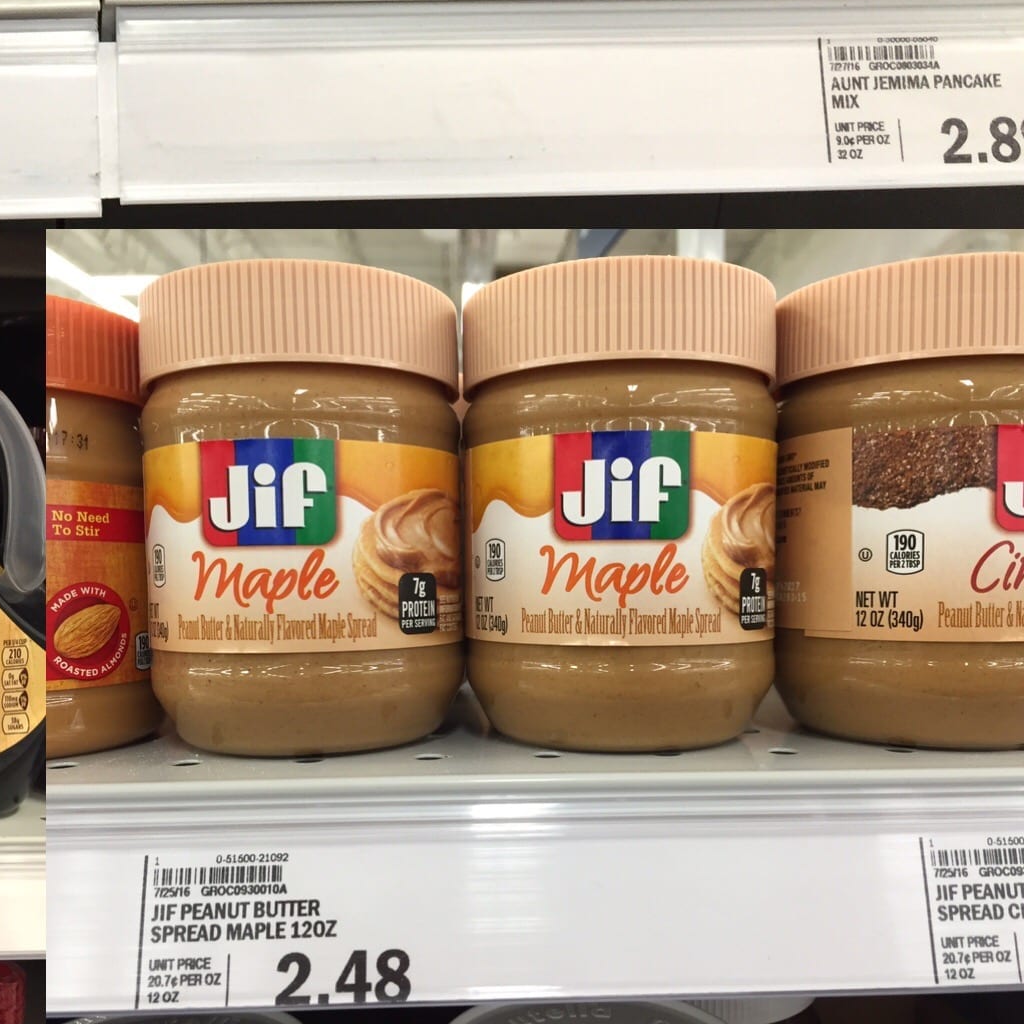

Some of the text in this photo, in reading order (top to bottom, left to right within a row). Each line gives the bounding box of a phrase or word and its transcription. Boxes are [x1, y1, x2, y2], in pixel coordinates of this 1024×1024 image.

[831, 73, 1002, 91] AUNT JEMIMA PANCAKE
[832, 94, 860, 109] MIX
[940, 116, 1024, 164] 2.8
[209, 462, 328, 531] Jif
[562, 456, 682, 525] Jif
[51, 510, 110, 523] No Need
[53, 525, 100, 537] To Stir
[894, 535, 916, 550] 190
[192, 548, 340, 614] Maple
[539, 543, 689, 608] Maple
[413, 578, 426, 597] 7g
[50, 587, 107, 613] MADE WITH
[402, 600, 435, 617] PROTEIN
[856, 591, 898, 608] NET WT
[178, 614, 199, 640] Peanut
[201, 614, 224, 640] Butter
[226, 615, 232, 640] &
[234, 614, 275, 644] Naturally
[276, 613, 316, 640] Flavored
[318, 613, 346, 643] Maple
[347, 612, 377, 643] Spread
[401, 618, 436, 628] PER SERVING
[856, 610, 924, 632] 12 OZ (340g)
[53, 656, 99, 677] ROASTED
[100, 632, 127, 673] ALMONDS
[154, 884, 287, 898] 7/25/16 GROC0930010A
[936, 884, 958, 901] JIF
[151, 899, 320, 921] JIF PEANUT BUTTER
[937, 903, 1004, 922] SPREAD
[151, 920, 338, 943] SPREAD MAPLE 12OZ
[149, 957, 211, 971] UNIT PRICE
[147, 973, 221, 987] 20.7¢ PER OZ
[276, 949, 412, 1004] 2.48
[147, 991, 180, 1003] 12 OZ
